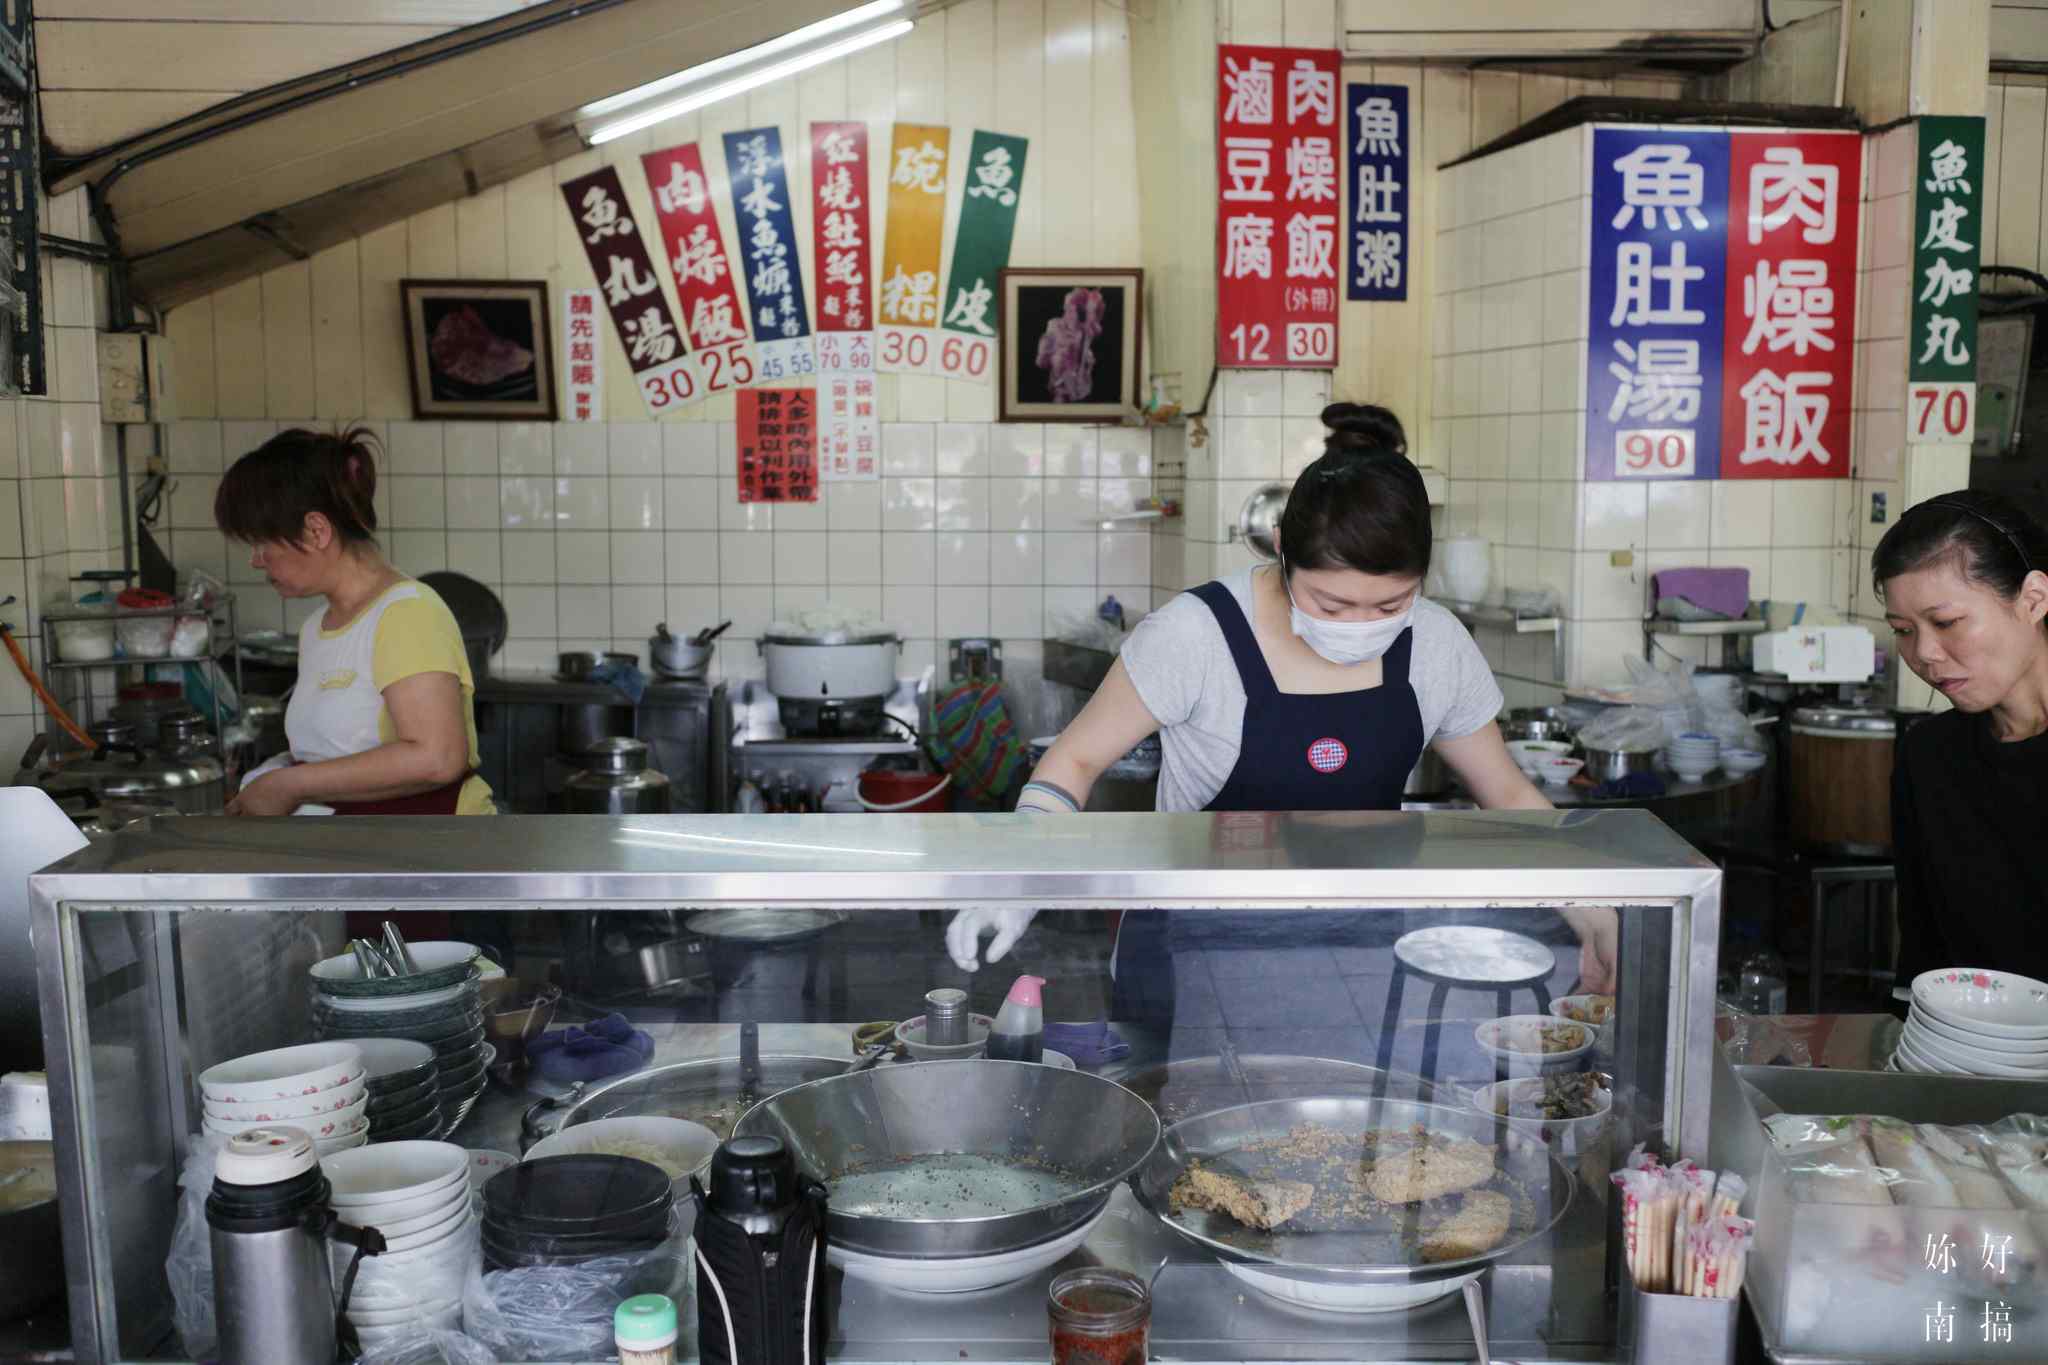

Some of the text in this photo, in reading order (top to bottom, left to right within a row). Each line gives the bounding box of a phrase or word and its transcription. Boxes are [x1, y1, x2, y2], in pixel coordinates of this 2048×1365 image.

[1223, 57, 1274, 279] 滷豆腐
[1285, 59, 1336, 279] 肉燥飯
[1355, 97, 1401, 288] 魚肚粥
[656, 162, 747, 346] 肉燥飯
[883, 140, 945, 321] 碗粿
[945, 147, 1016, 336] 魚皮
[1919, 139, 1974, 366] 魚皮加丸
[582, 186, 676, 363] 魚丸湯
[1608, 144, 1709, 424] 魚肚湯
[1739, 147, 1839, 465] 肉燥飯
[700, 338, 754, 391] 25
[761, 353, 813, 378] 45 55
[820, 335, 869, 350] 小 大
[820, 353, 871, 368] 70 90
[883, 331, 928, 366] 30
[941, 338, 988, 376] 60
[1229, 323, 1270, 361] 12
[1293, 327, 1329, 357] 30
[645, 368, 694, 408] 30
[1915, 390, 1968, 435] 70
[1624, 435, 1686, 469] 90
